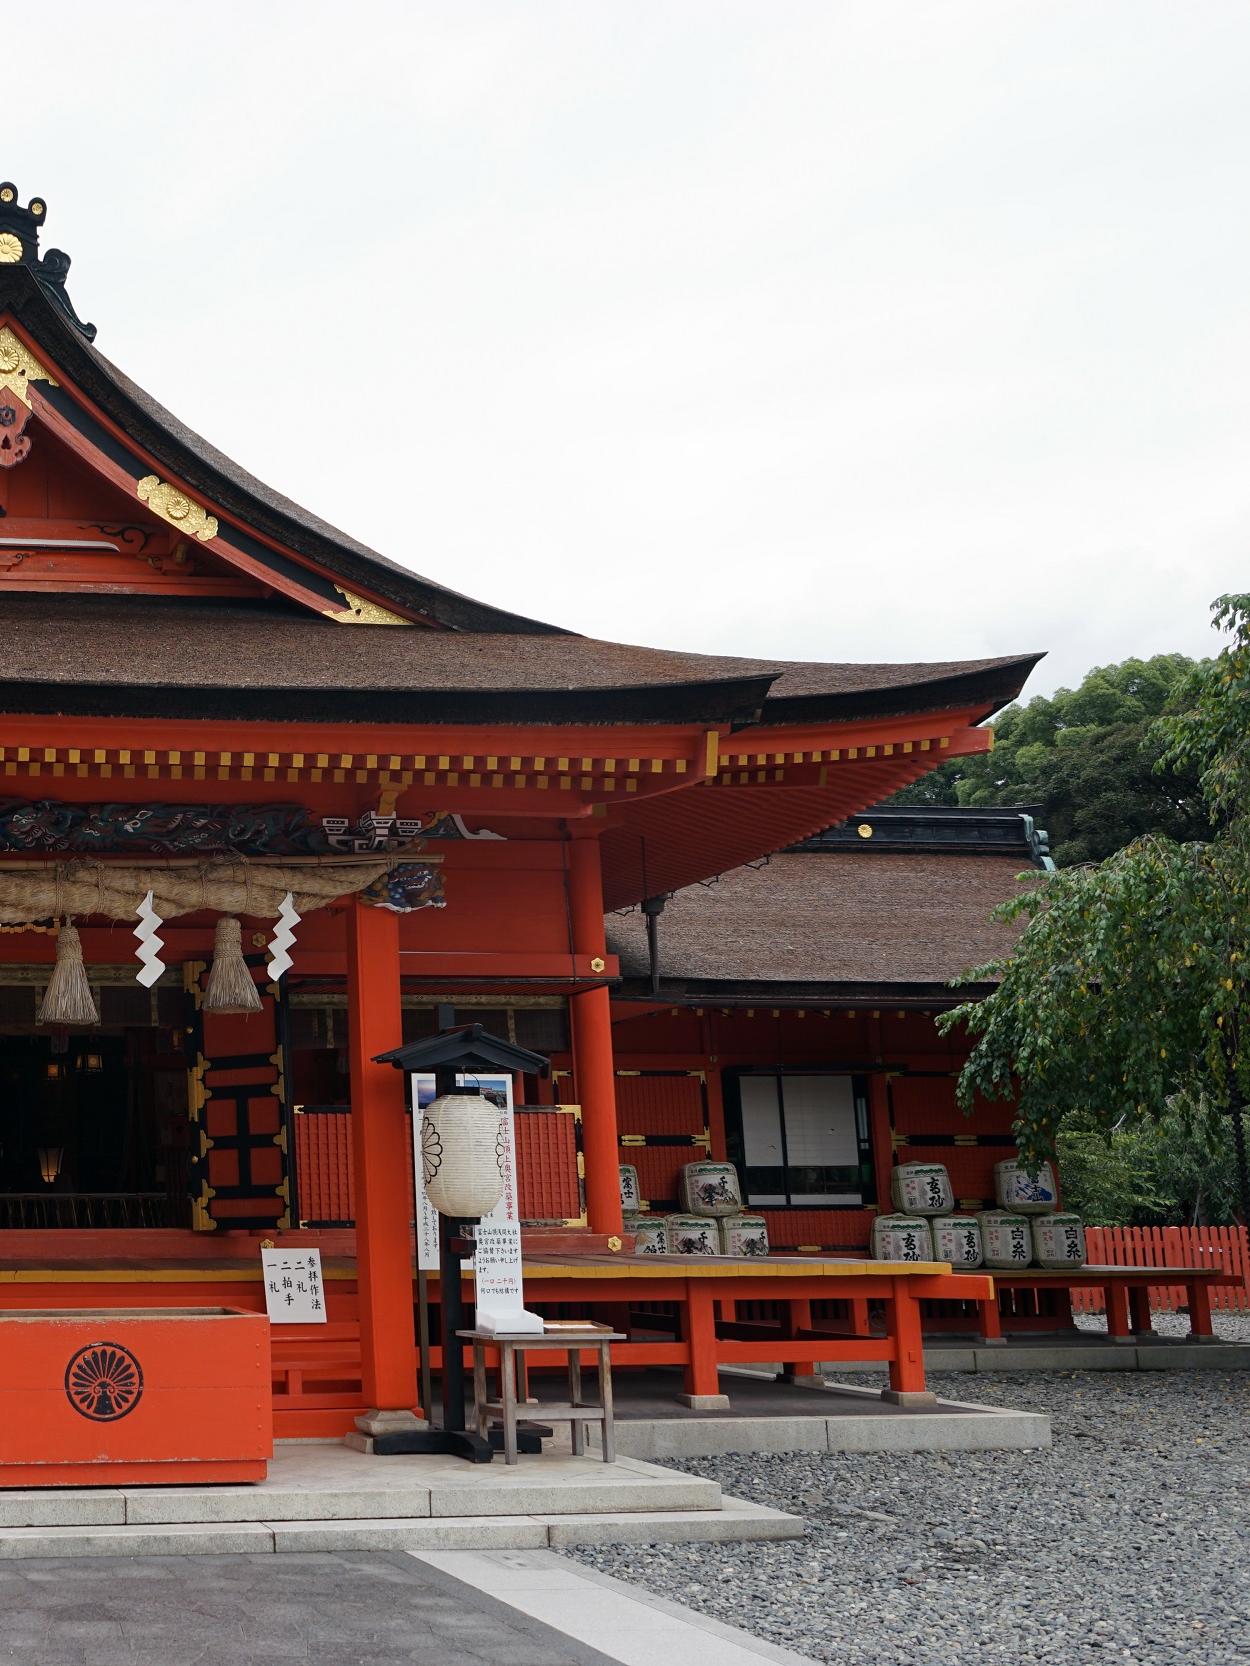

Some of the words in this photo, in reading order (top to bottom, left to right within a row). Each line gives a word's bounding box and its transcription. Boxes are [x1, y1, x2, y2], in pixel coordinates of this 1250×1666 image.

[926, 1177, 945, 1208] 高砂
[963, 1231, 980, 1262] 高砂
[1011, 1226, 1027, 1260] 白糸
[1064, 1226, 1082, 1260] 白糸
[267, 1263, 280, 1293] 一礼
[281, 1261, 294, 1306] 二拍手
[294, 1261, 307, 1293] 二礼
[307, 1256, 321, 1309] 参拝作法
